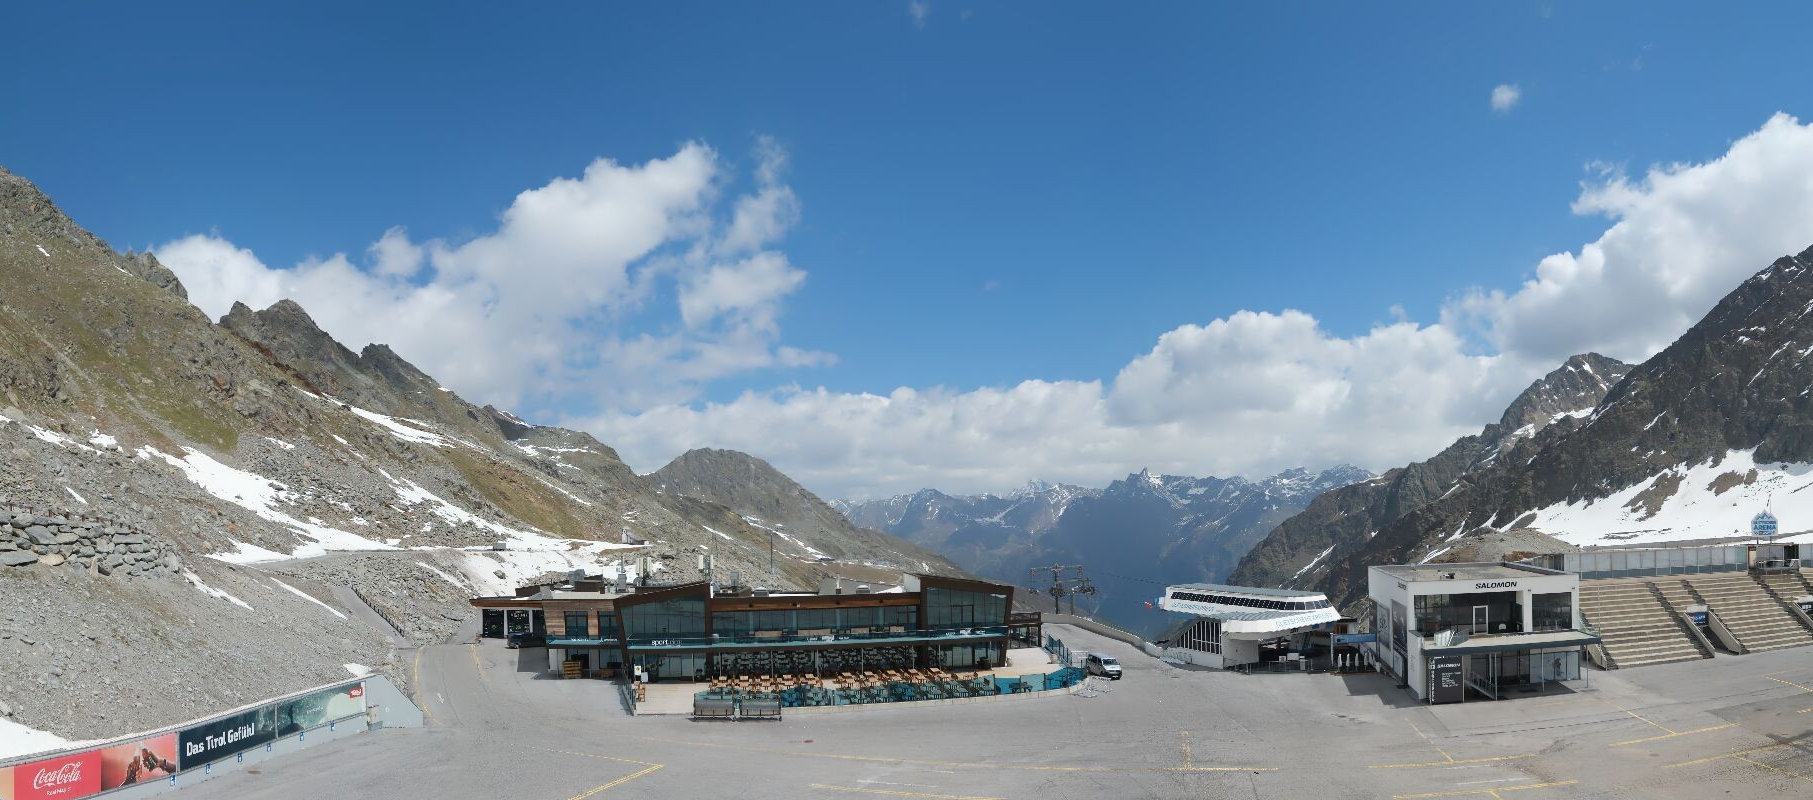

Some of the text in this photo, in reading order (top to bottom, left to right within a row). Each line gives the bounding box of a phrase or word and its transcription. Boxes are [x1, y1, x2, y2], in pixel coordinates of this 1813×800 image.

[1475, 581, 1517, 589] SALOMON
[186, 722, 255, 757] Das Tirol Gefühl
